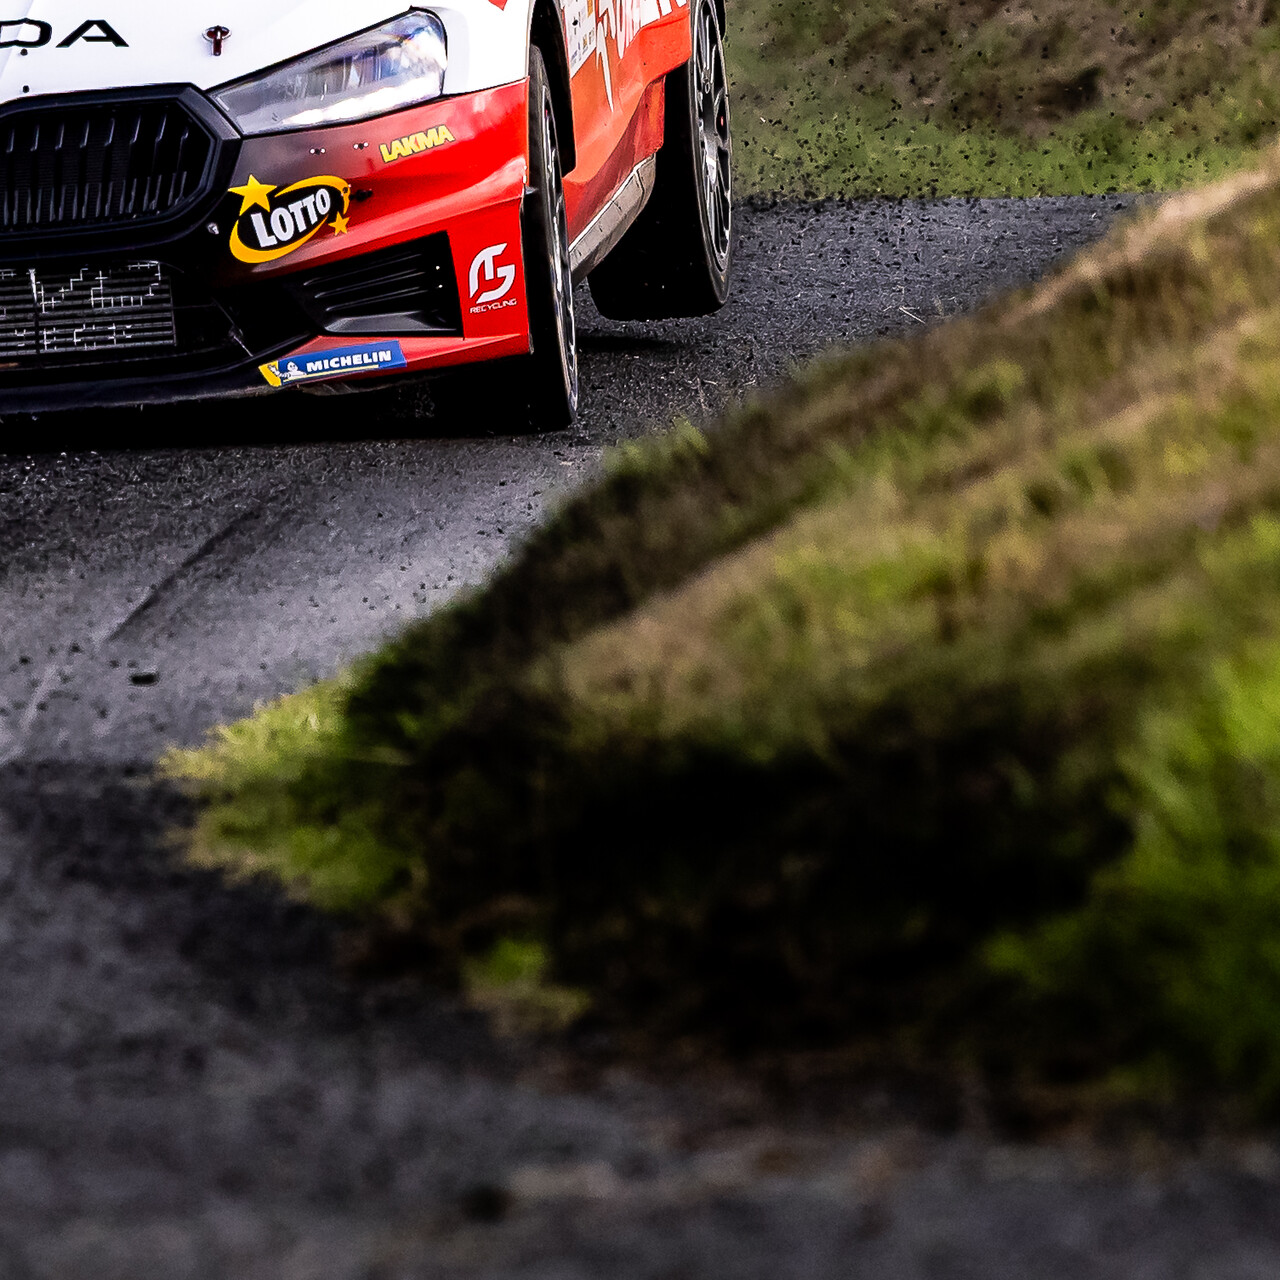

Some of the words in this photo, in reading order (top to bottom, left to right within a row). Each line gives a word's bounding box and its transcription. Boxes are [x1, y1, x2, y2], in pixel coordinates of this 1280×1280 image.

[379, 124, 454, 163] LAKMA
[251, 188, 331, 248] LOTTO
[469, 298, 517, 314] RECYCLING
[306, 350, 392, 372] MICHELIN
